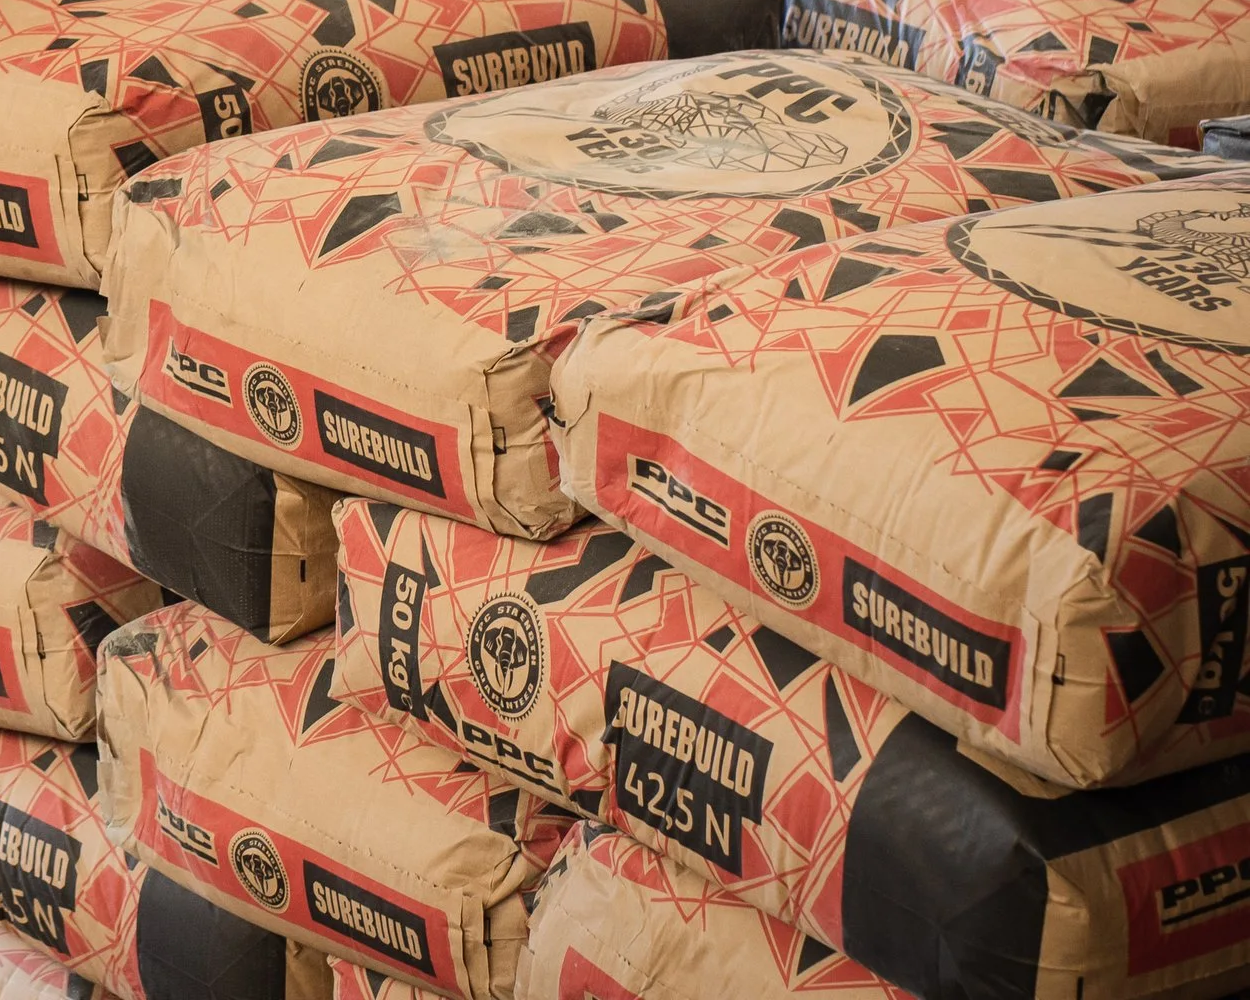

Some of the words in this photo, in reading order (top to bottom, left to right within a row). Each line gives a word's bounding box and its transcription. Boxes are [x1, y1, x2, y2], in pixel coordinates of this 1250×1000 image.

[451, 39, 587, 97] SUREBUILD
[716, 61, 858, 125] PPC
[1115, 255, 1232, 312] YEARS
[15, 444, 39, 490] N
[322, 409, 433, 482] SUREBUILD
[635, 457, 727, 529] PPC
[392, 573, 418, 631] 50
[388, 637, 413, 684] kg
[473, 614, 492, 643] PPC
[497, 605, 537, 667] STRENGTH
[851, 581, 995, 689] SUREBUILD
[474, 659, 534, 710] GUARANTEED
[461, 720, 555, 780] PPC
[611, 686, 755, 798] SUREBUILD
[624, 761, 694, 833] 42,5
[705, 803, 731, 857] N
[33, 896, 57, 940] N
[312, 880, 422, 961] SUREBUILD
